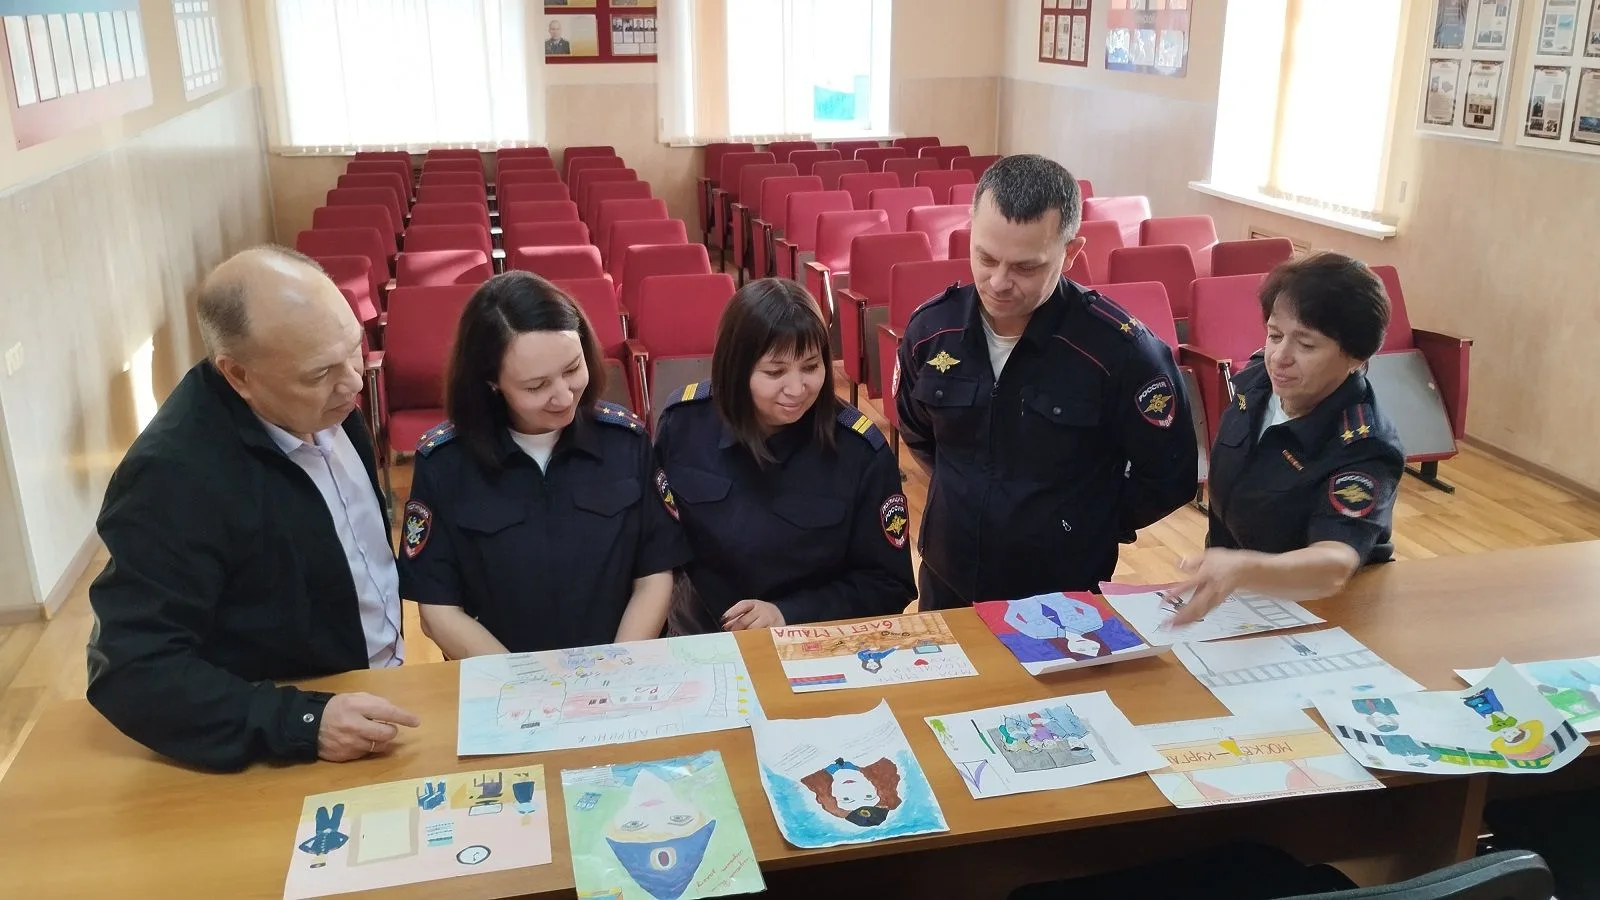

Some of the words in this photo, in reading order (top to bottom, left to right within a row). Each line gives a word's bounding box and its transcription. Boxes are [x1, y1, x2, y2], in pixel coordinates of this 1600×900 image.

[1138, 381, 1167, 402] РОССИЯ
[885, 505, 905, 522] РОССИЯ
[775, 628, 831, 638] МАША
[1242, 741, 1292, 756] МОСКВ
